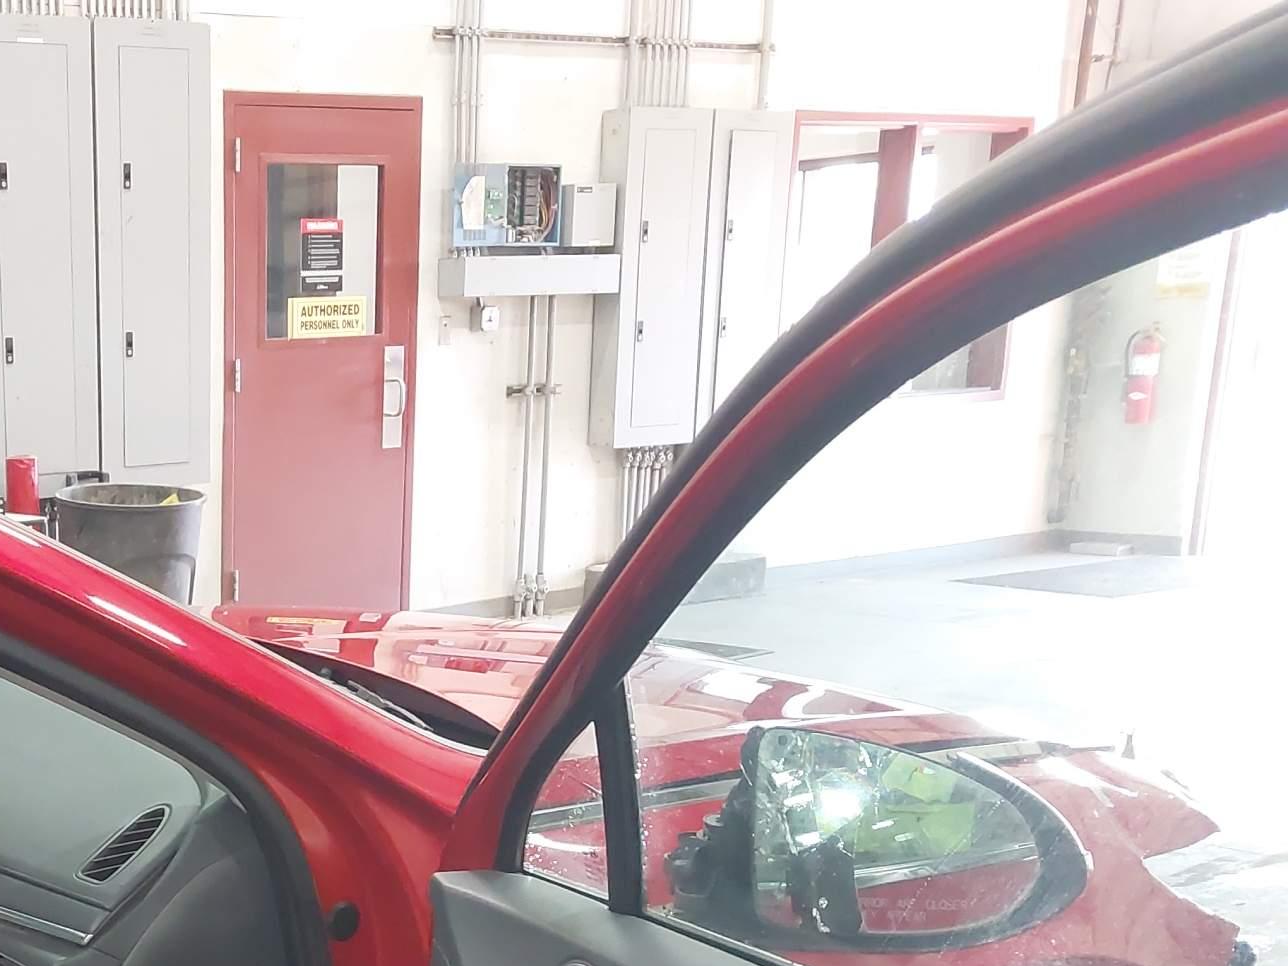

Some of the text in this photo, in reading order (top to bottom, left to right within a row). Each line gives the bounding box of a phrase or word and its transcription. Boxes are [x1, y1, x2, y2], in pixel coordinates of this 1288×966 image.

[300, 304, 360, 317] AUTHORIZED
[300, 318, 360, 331] PERSONNEL ONLY
